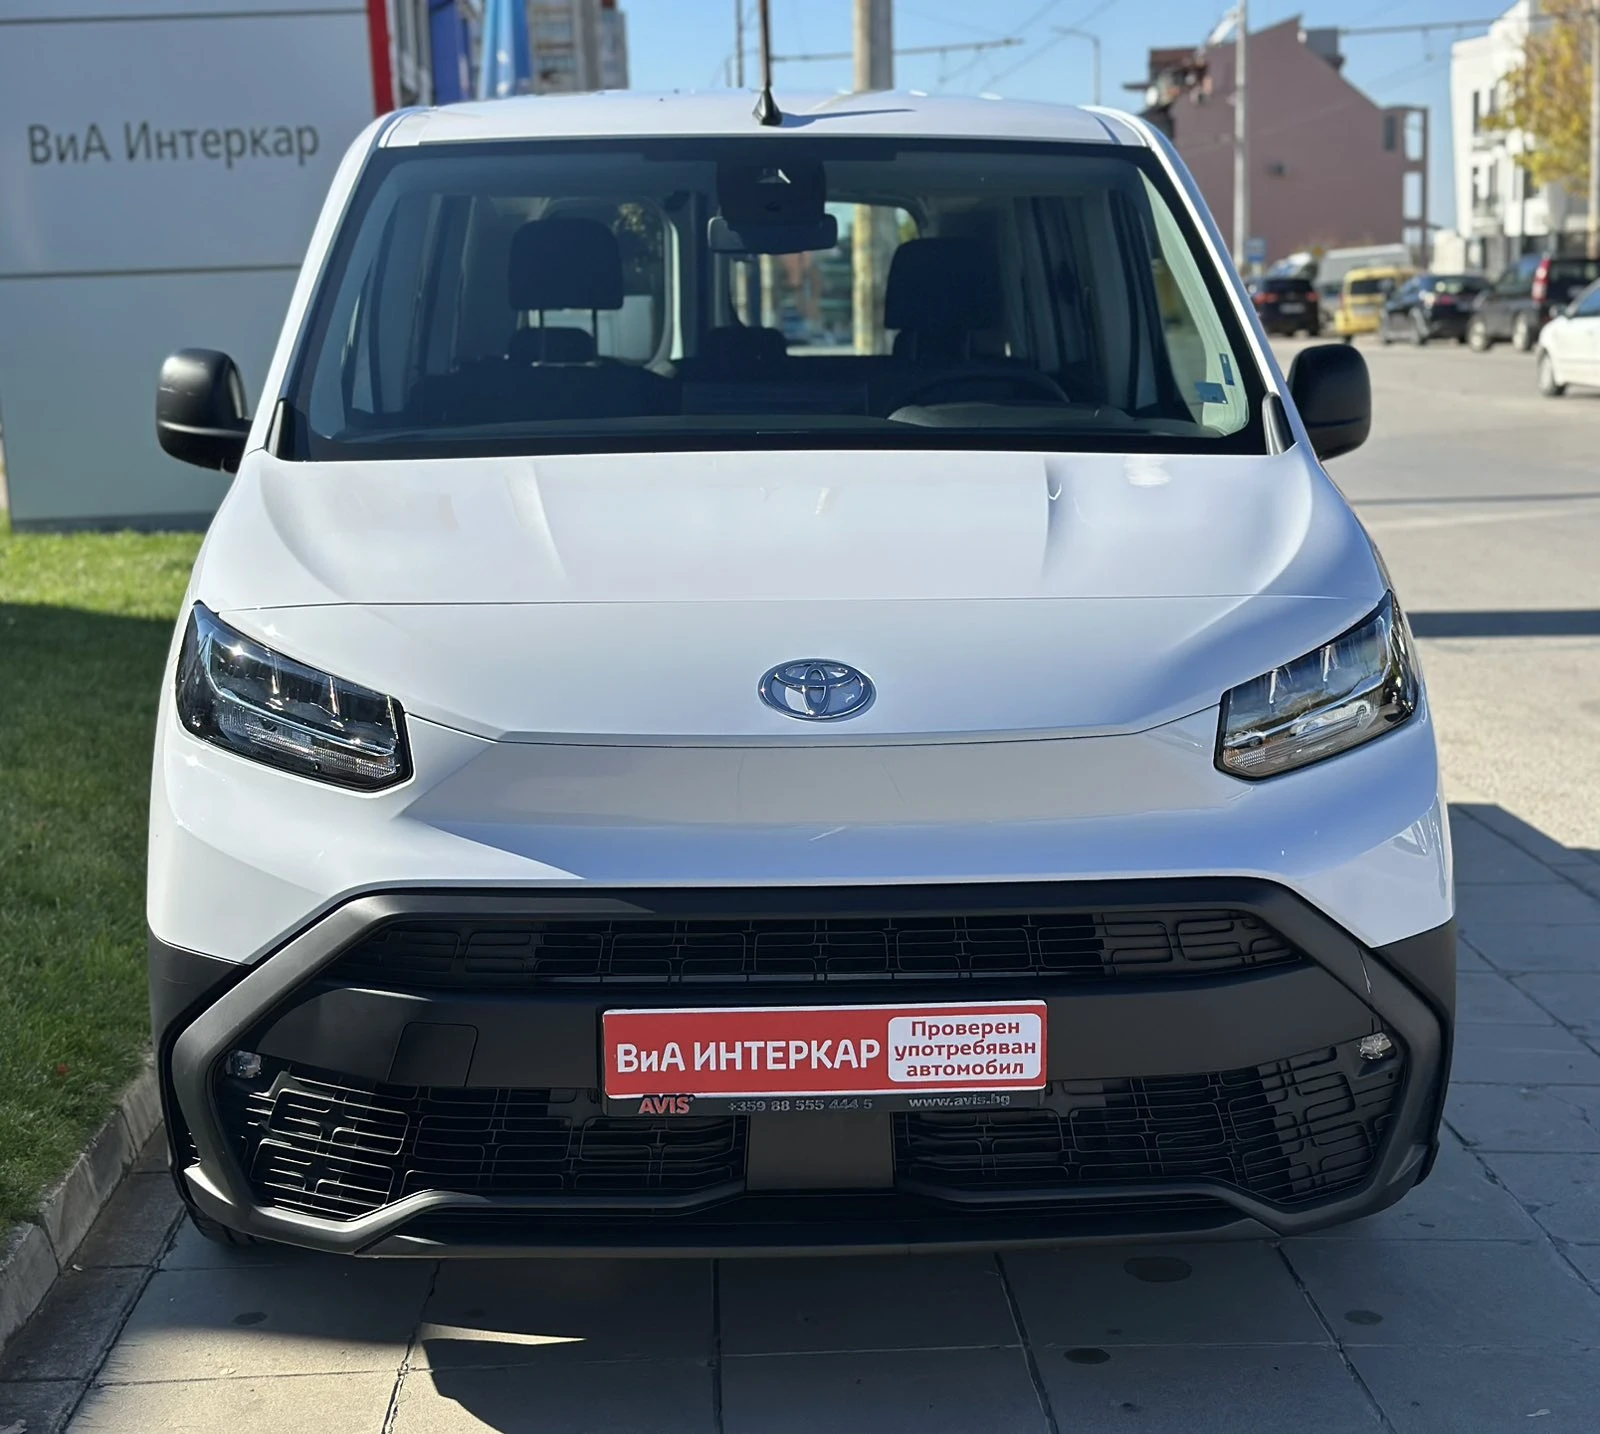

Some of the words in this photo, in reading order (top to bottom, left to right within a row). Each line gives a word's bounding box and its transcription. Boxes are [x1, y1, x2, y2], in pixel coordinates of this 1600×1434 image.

[27, 122, 111, 165] ВиА
[124, 120, 320, 168] Интеркар
[911, 1019, 1021, 1039] Проверен
[616, 1042, 685, 1073] ВиА
[694, 1038, 881, 1071] ИНТЕРКАР
[894, 1038, 1037, 1061] употребяван
[906, 1059, 1025, 1077] автомобил
[638, 1096, 692, 1115] AVIS
[728, 1100, 766, 1112] +359
[770, 1099, 790, 1111] 88
[795, 1099, 825, 1111] 555
[908, 1093, 1011, 1108] www.avis.bg
